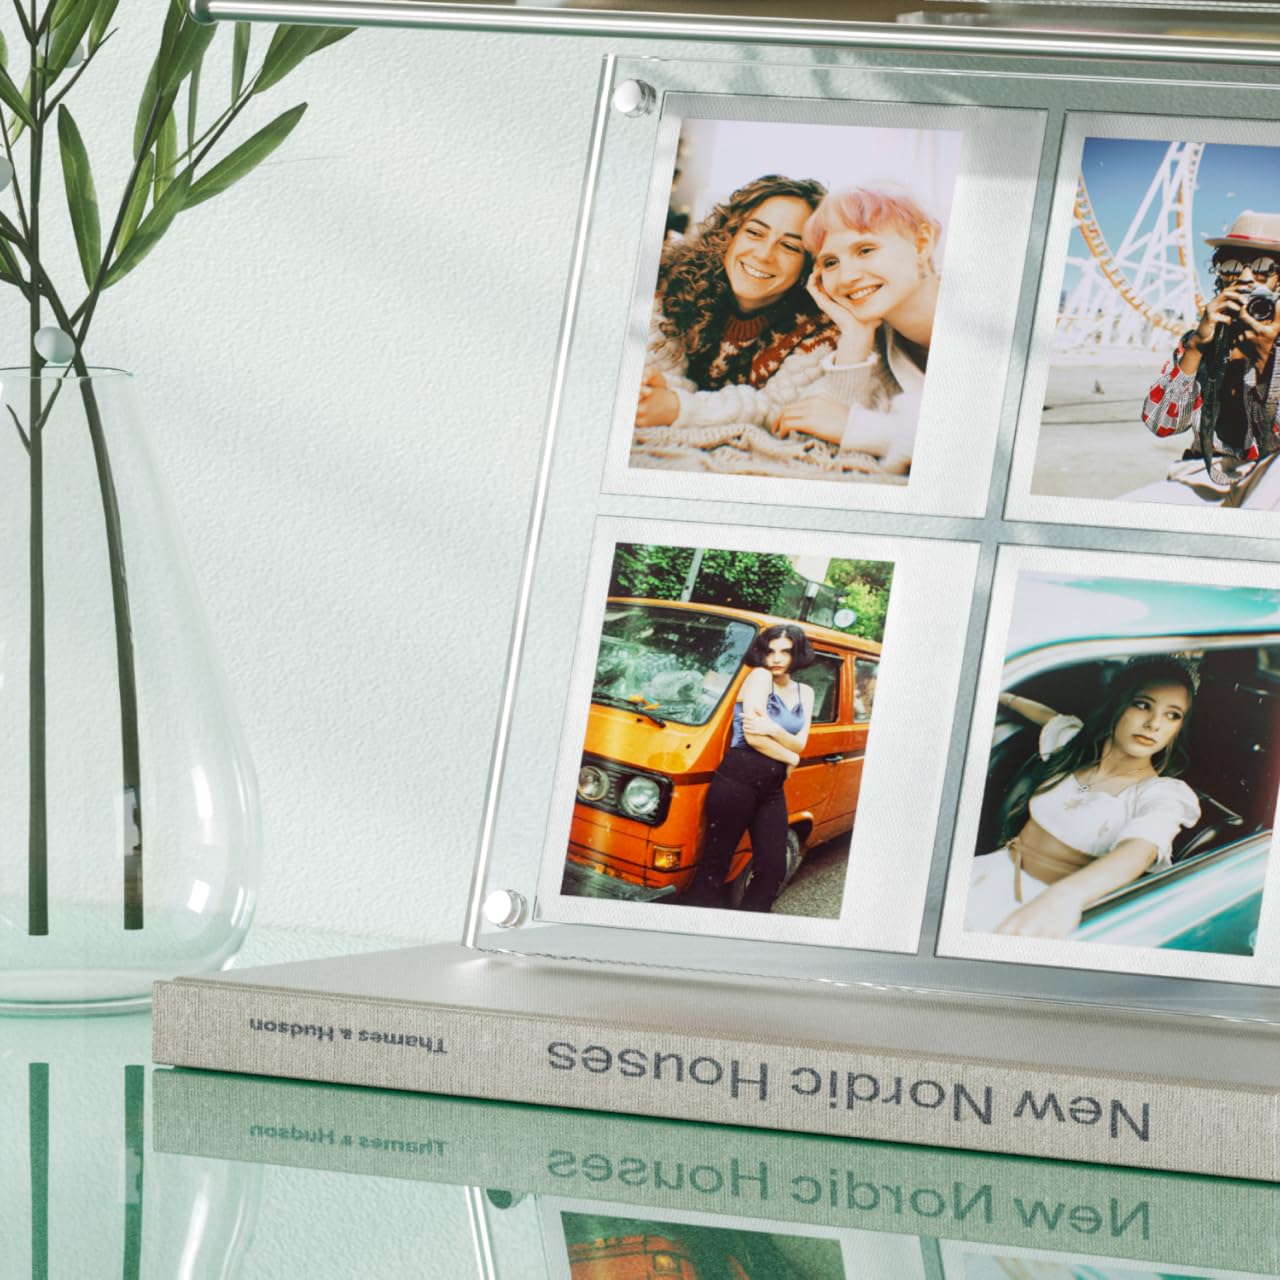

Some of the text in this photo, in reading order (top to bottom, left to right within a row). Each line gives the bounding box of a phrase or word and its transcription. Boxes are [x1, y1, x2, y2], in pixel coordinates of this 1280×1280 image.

[250, 1018, 334, 1042] Hudson
[358, 1027, 448, 1054] Thames
[547, 1041, 1150, 1142] New Nordic Houses
